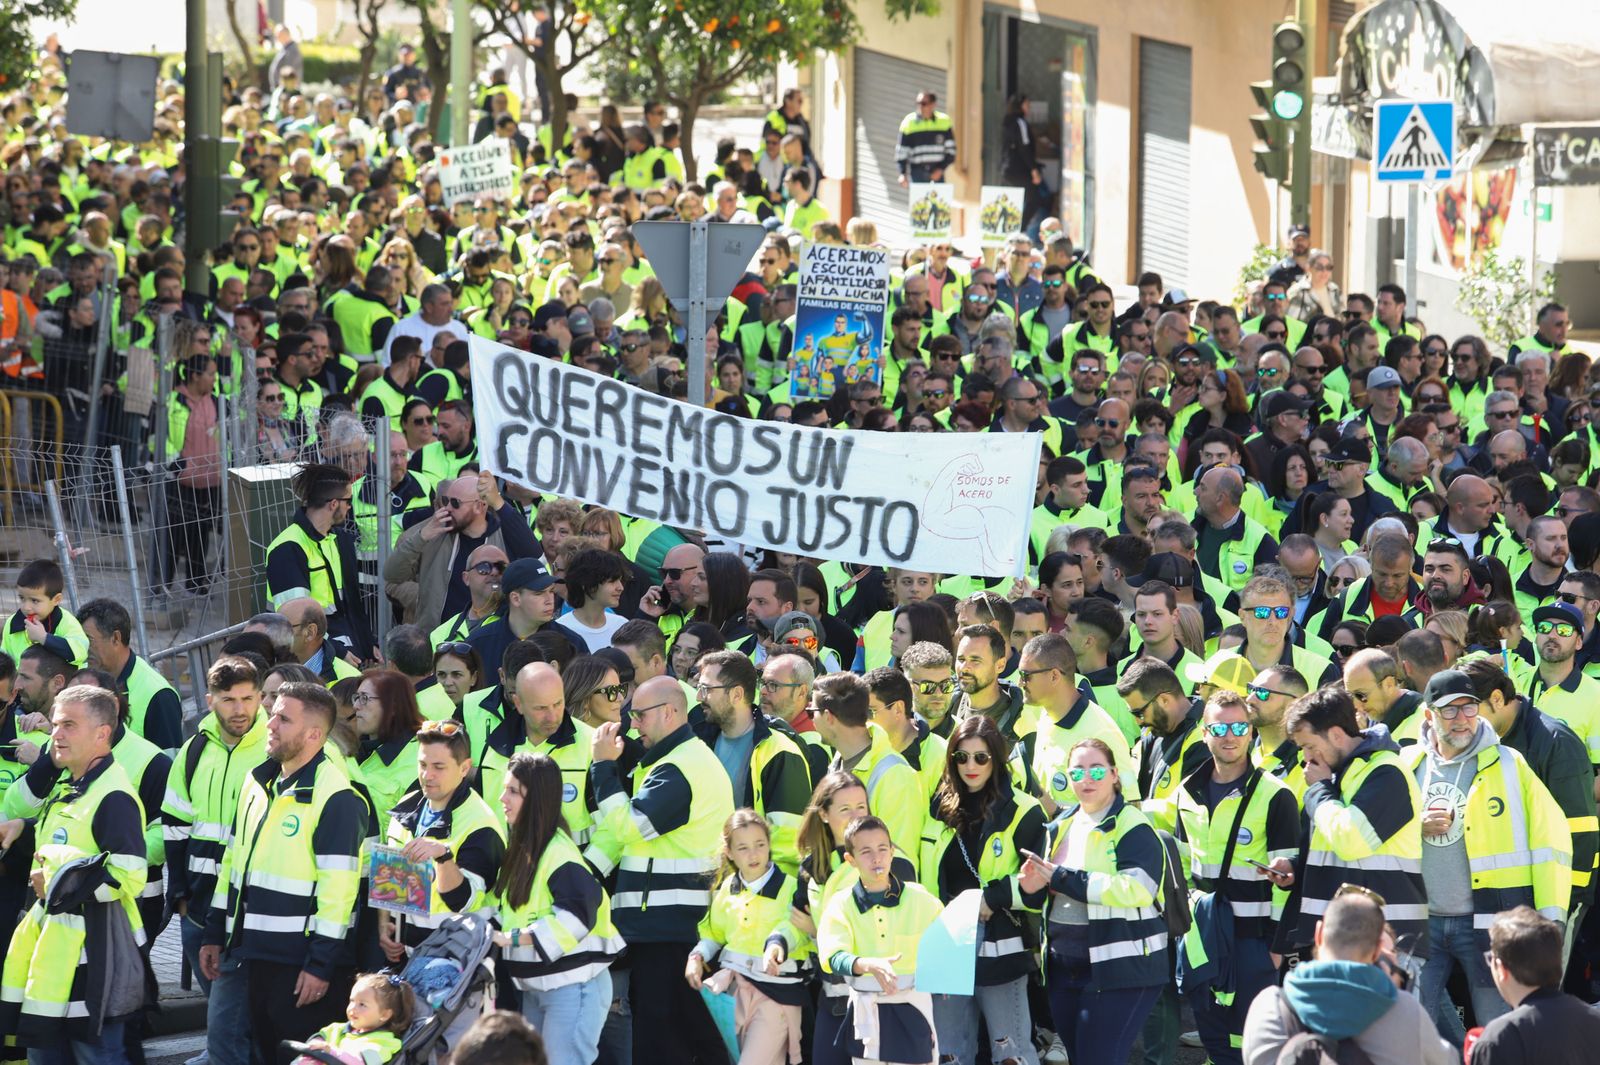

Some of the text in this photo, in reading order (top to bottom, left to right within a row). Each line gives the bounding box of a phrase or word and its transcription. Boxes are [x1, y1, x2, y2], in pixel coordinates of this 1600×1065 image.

[807, 245, 886, 264] ACERINOX
[811, 262, 875, 276] ESCUCHA
[801, 286, 884, 301] EN LA LUCHA
[800, 298, 883, 313] FAMILIAS DE ACERO
[492, 351, 855, 491] QUEREMOS UN
[957, 475, 1012, 486] SOMOS DE
[495, 424, 919, 562] CONVENIO JUSTO
[959, 489, 993, 499] ACERO
